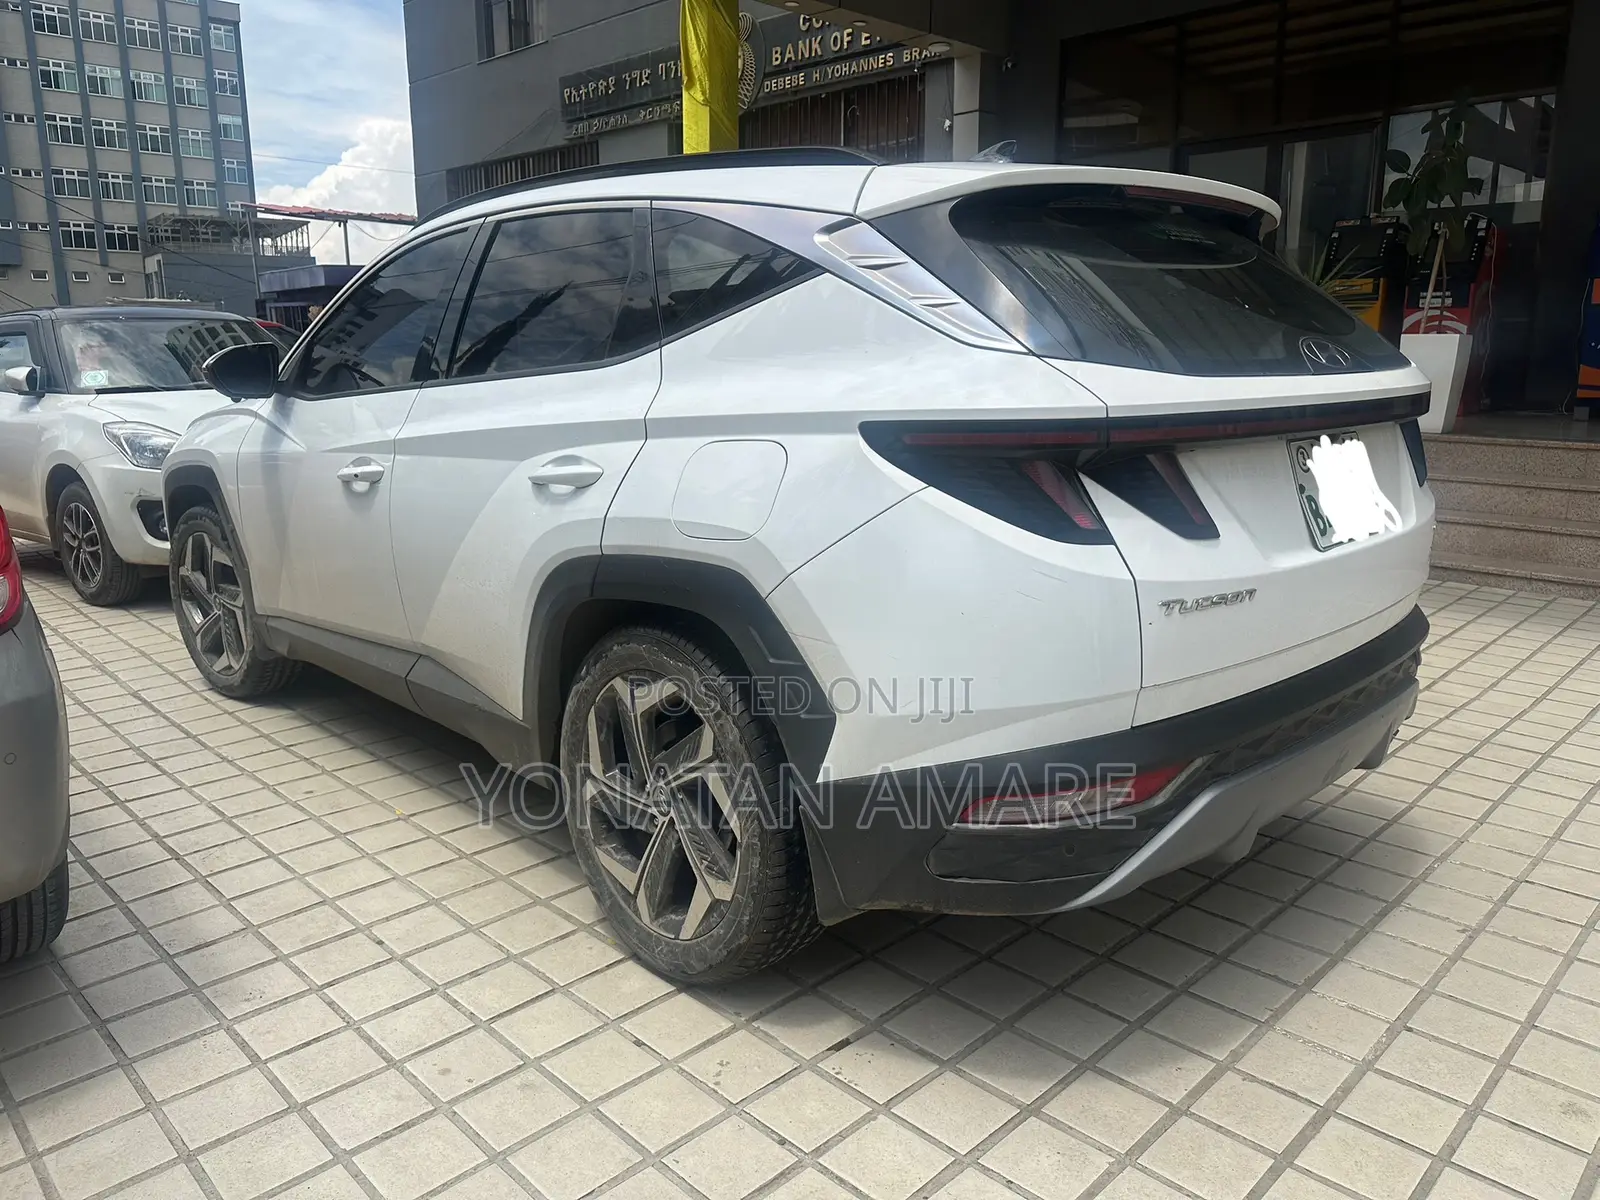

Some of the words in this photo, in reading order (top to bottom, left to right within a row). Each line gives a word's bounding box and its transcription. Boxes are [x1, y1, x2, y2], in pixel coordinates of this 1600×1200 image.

[772, 35, 823, 66] BANK
[830, 28, 853, 52] OF
[563, 76, 616, 105] የኢትዮጵያ
[622, 68, 652, 90] ንግድ
[764, 73, 806, 92] DEBEBE
[813, 52, 894, 83] H/YOHANNES
[1158, 588, 1257, 616] TUCSON
